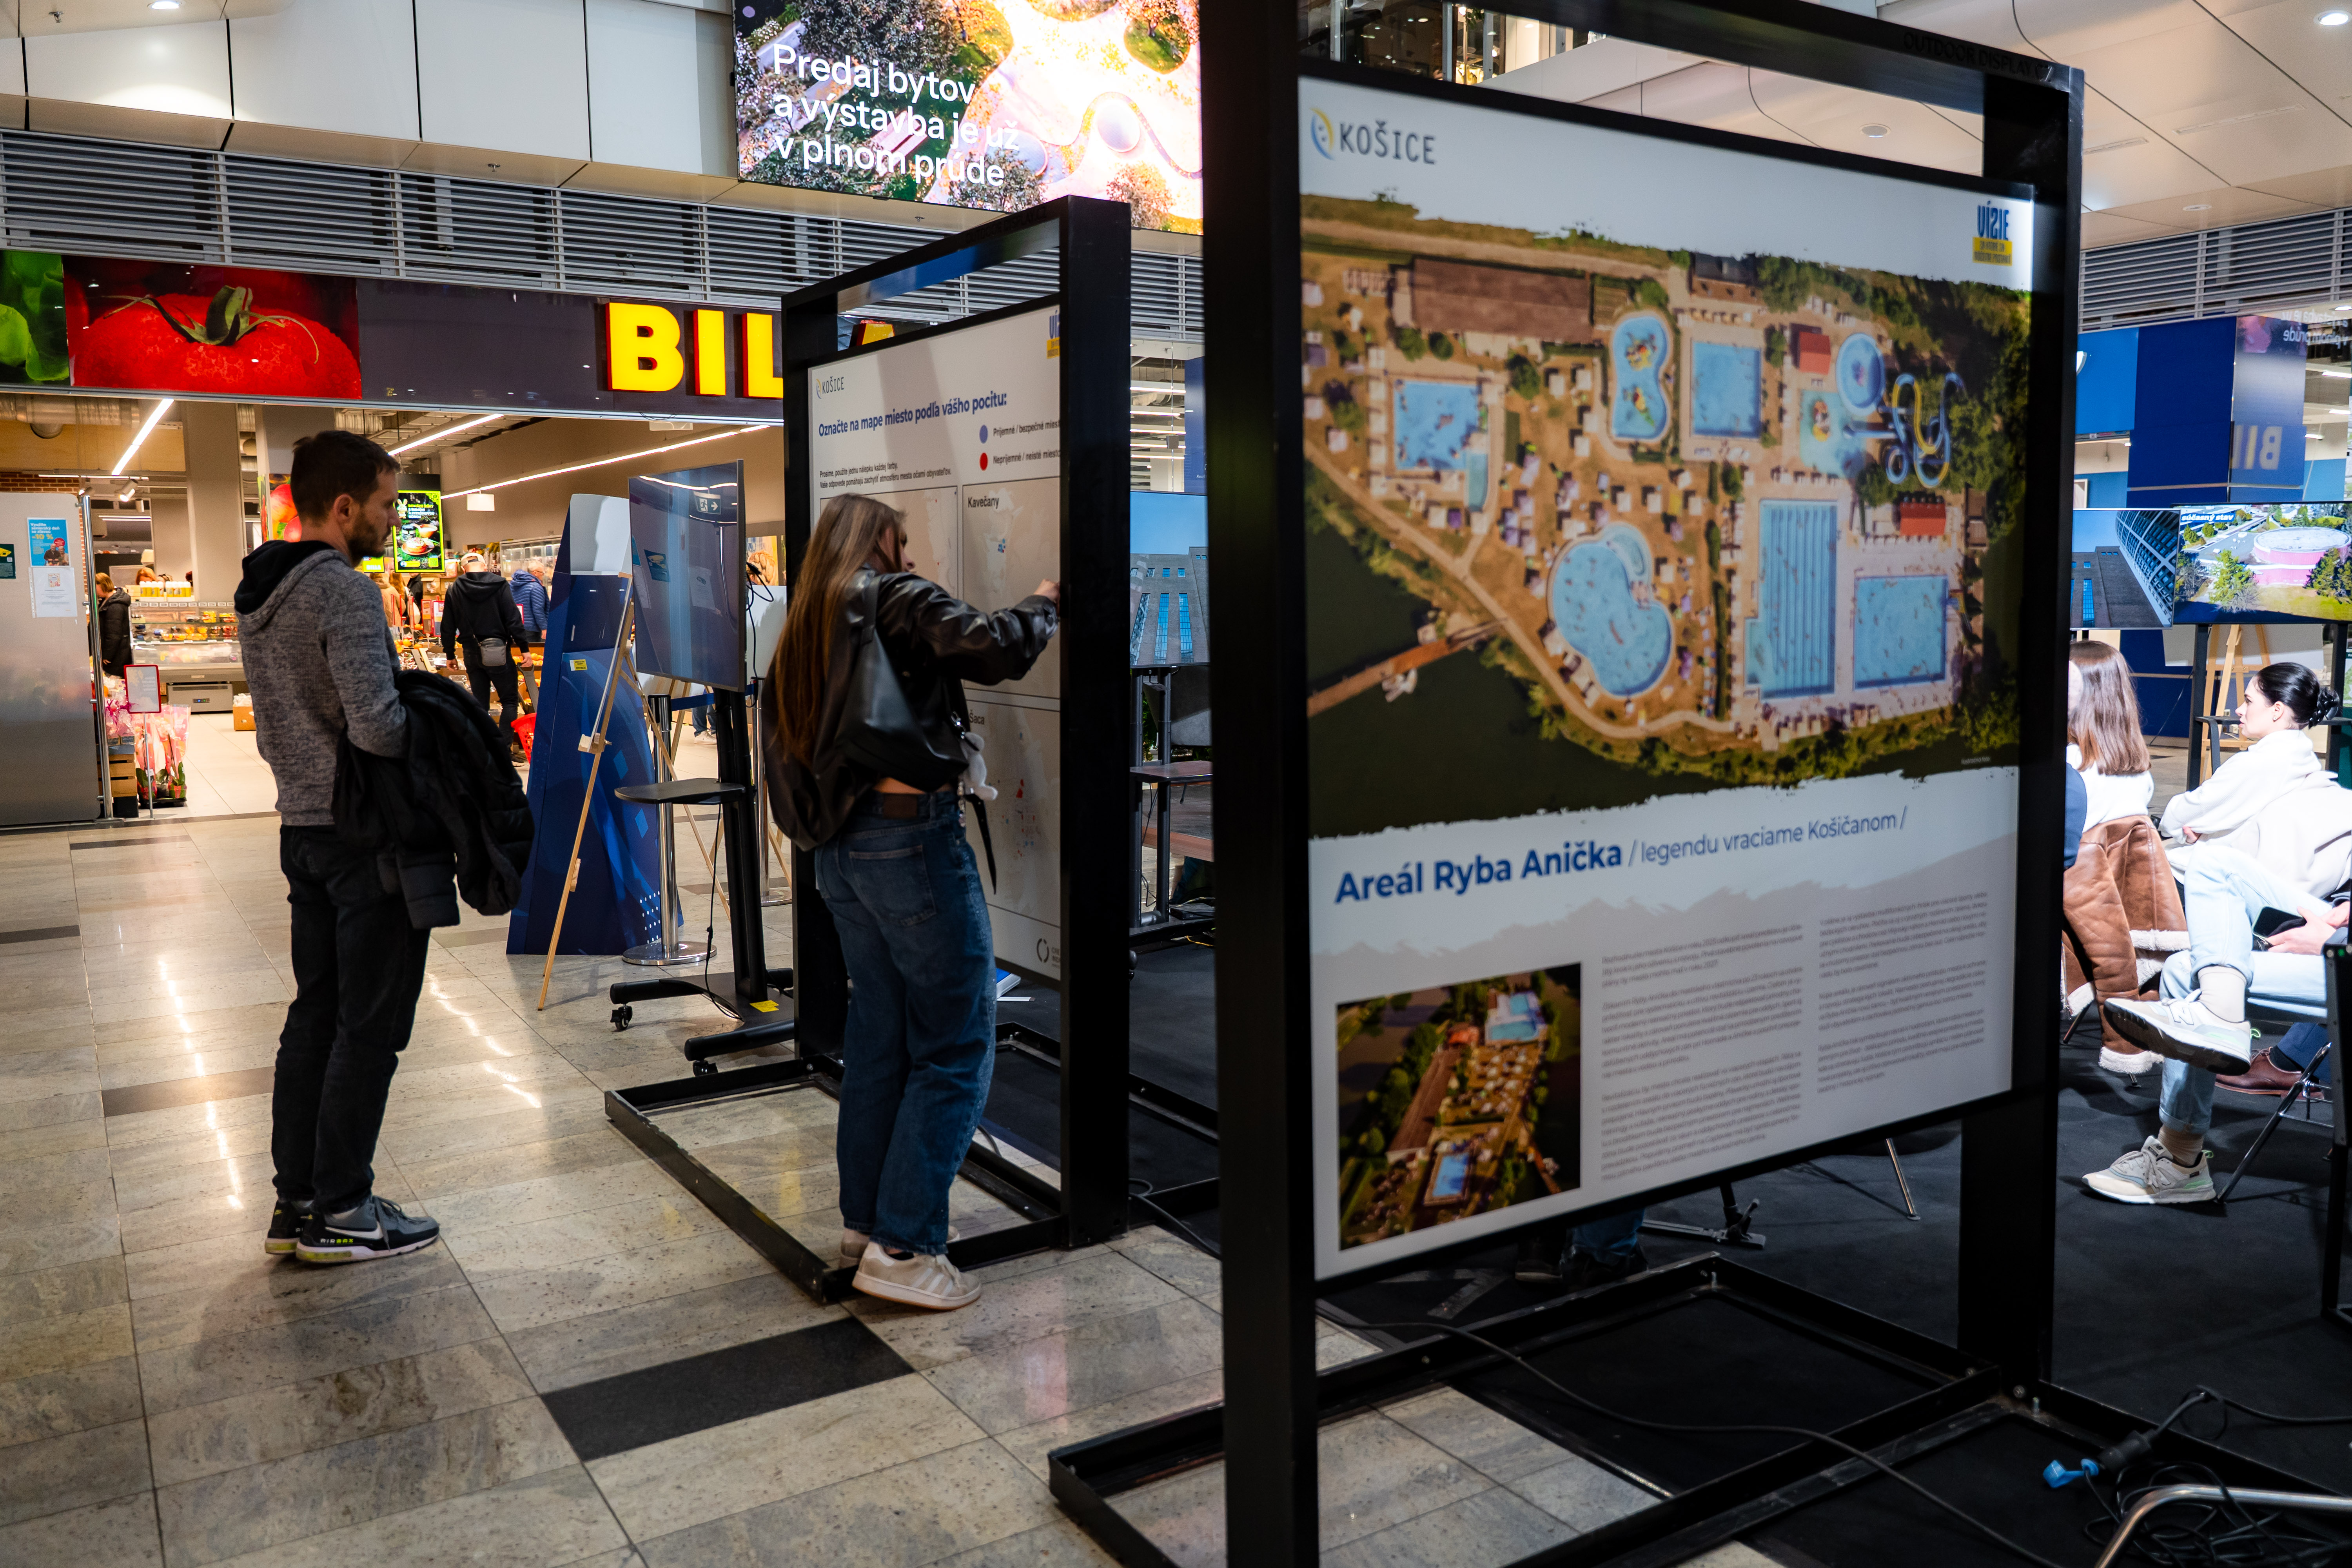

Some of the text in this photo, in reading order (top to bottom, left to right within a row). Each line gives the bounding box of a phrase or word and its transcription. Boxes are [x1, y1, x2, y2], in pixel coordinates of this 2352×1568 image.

[773, 43, 976, 105] Predaj bytov
[774, 94, 1019, 151] a výstavba je už
[1340, 120, 1436, 165] KOŠICE
[777, 132, 1005, 188] v plnom prúde
[1977, 200, 2009, 240] VÍZIE
[605, 302, 784, 399] BIL
[822, 376, 844, 394] KOŠICE
[819, 390, 1007, 437] Označte na mape miesto podľa vášho pocitu:
[967, 495, 999, 509] Kavečany
[969, 709, 984, 725] Šaca
[1335, 862, 1423, 904] Areál
[1434, 854, 1512, 895] Ryba
[1520, 840, 1622, 879] Anička
[1641, 834, 1718, 866] legendu
[1722, 826, 1802, 851] vraciame
[1807, 813, 1896, 840] Košičanom
